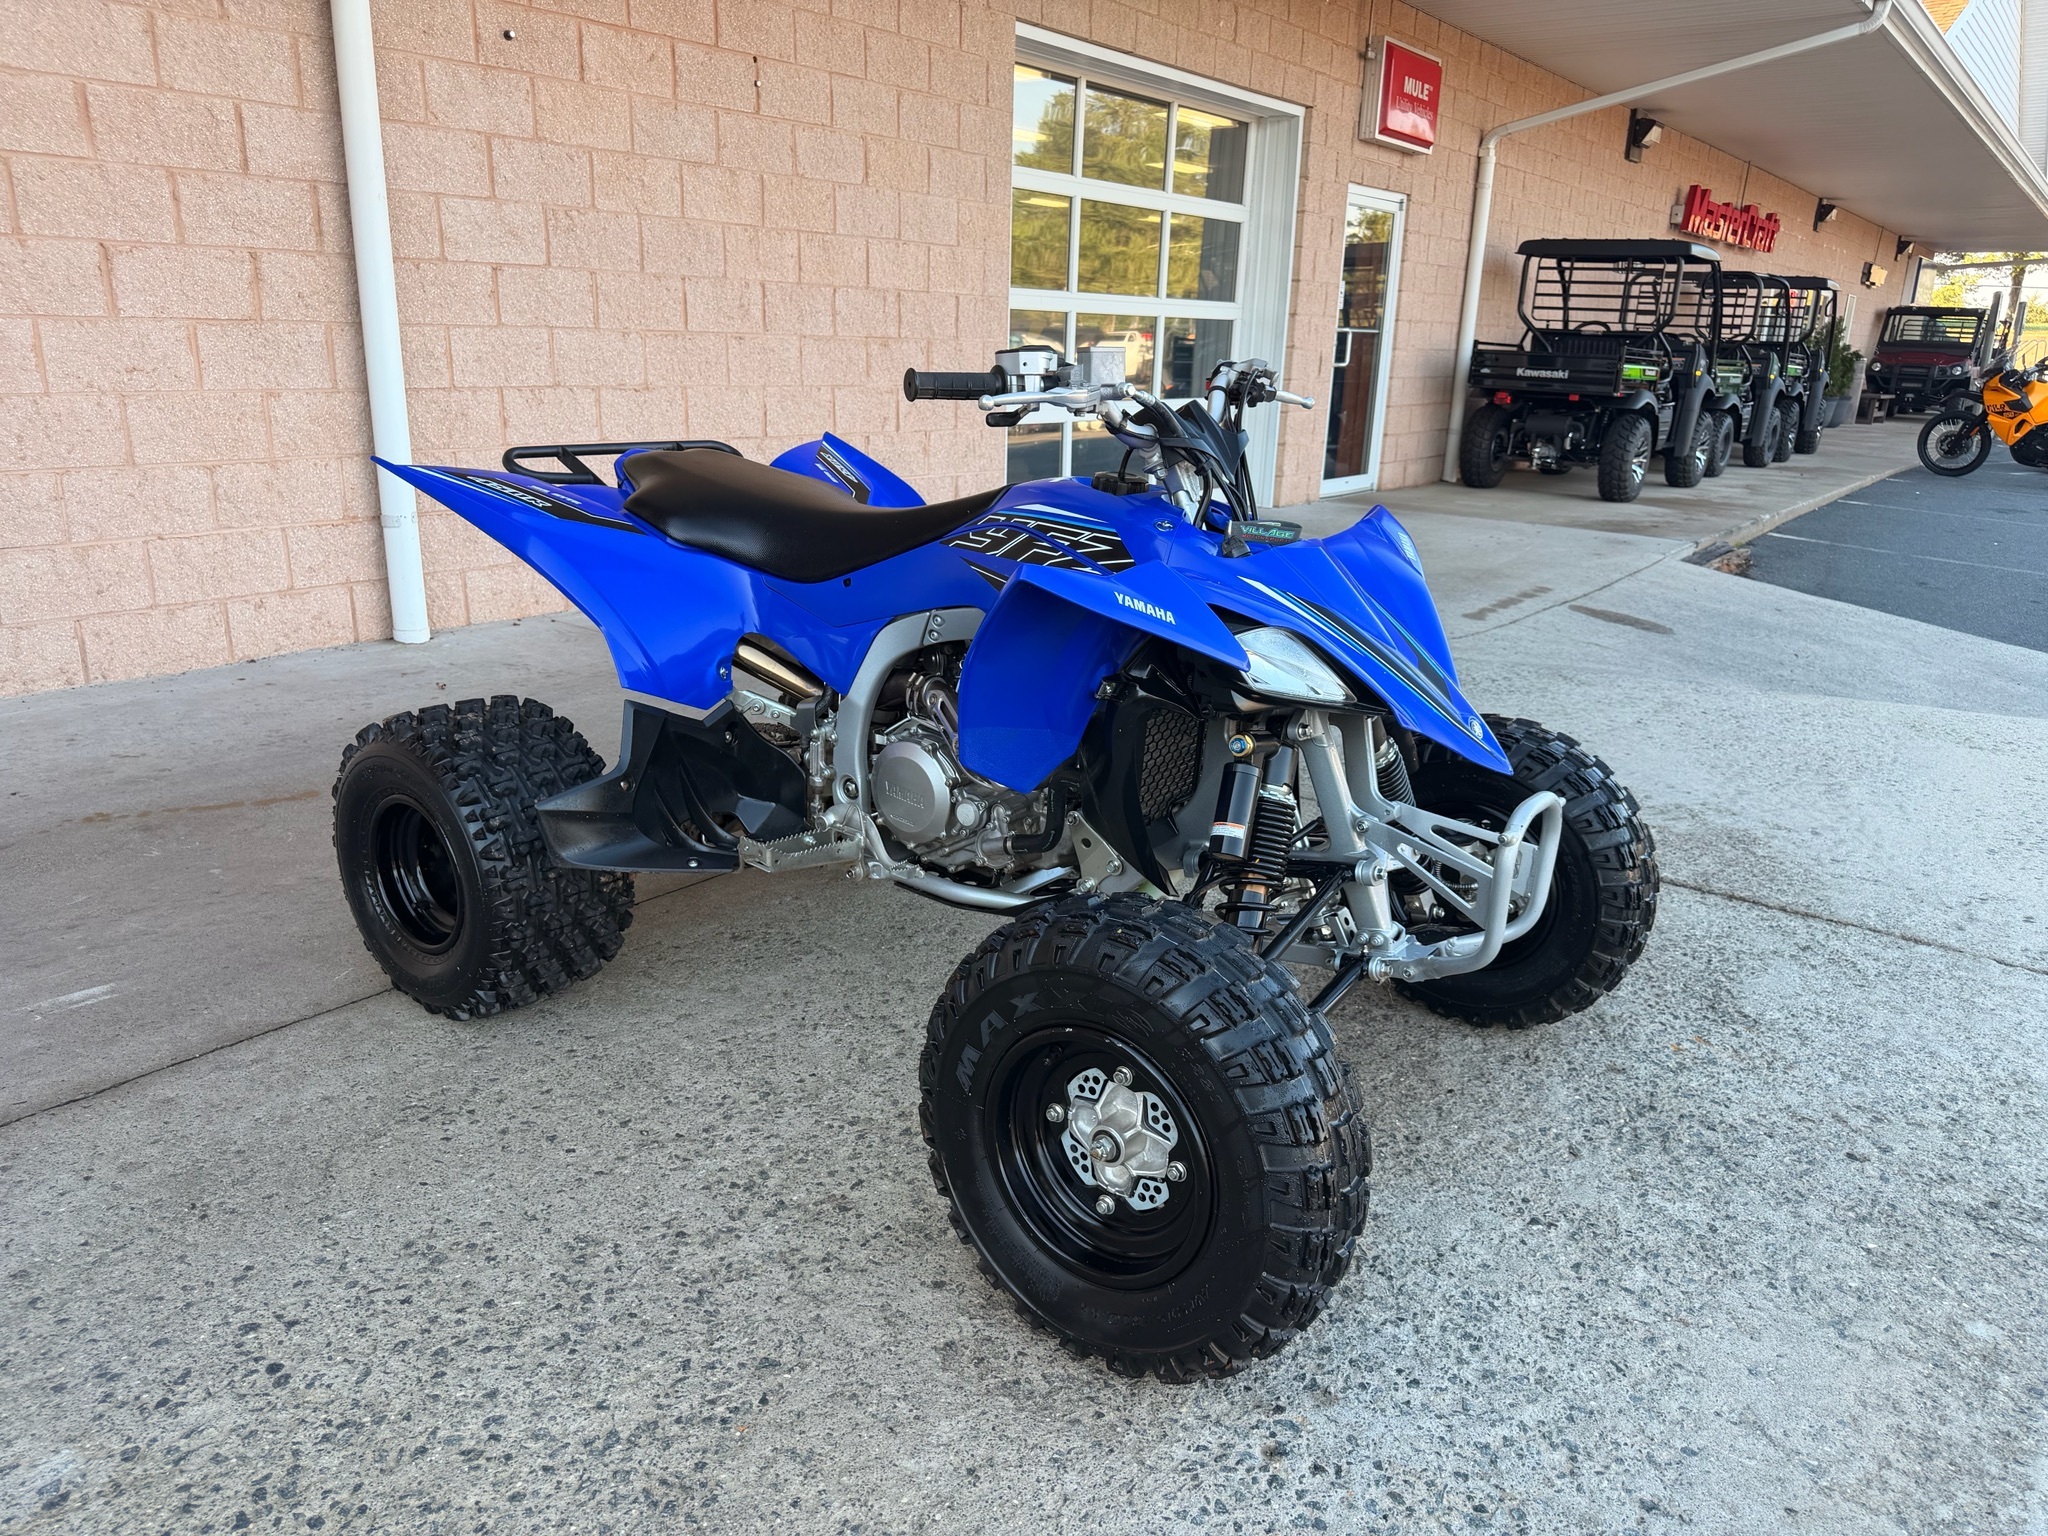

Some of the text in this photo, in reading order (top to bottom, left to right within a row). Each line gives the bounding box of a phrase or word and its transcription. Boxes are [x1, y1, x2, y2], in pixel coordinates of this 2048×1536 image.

[1403, 75, 1430, 101] MULE
[1681, 184, 1781, 253] MasterCraft
[1516, 367, 1569, 379] Kawasaki
[1240, 525, 1295, 538] VILLAGE
[1113, 590, 1176, 625] YAMAHA
